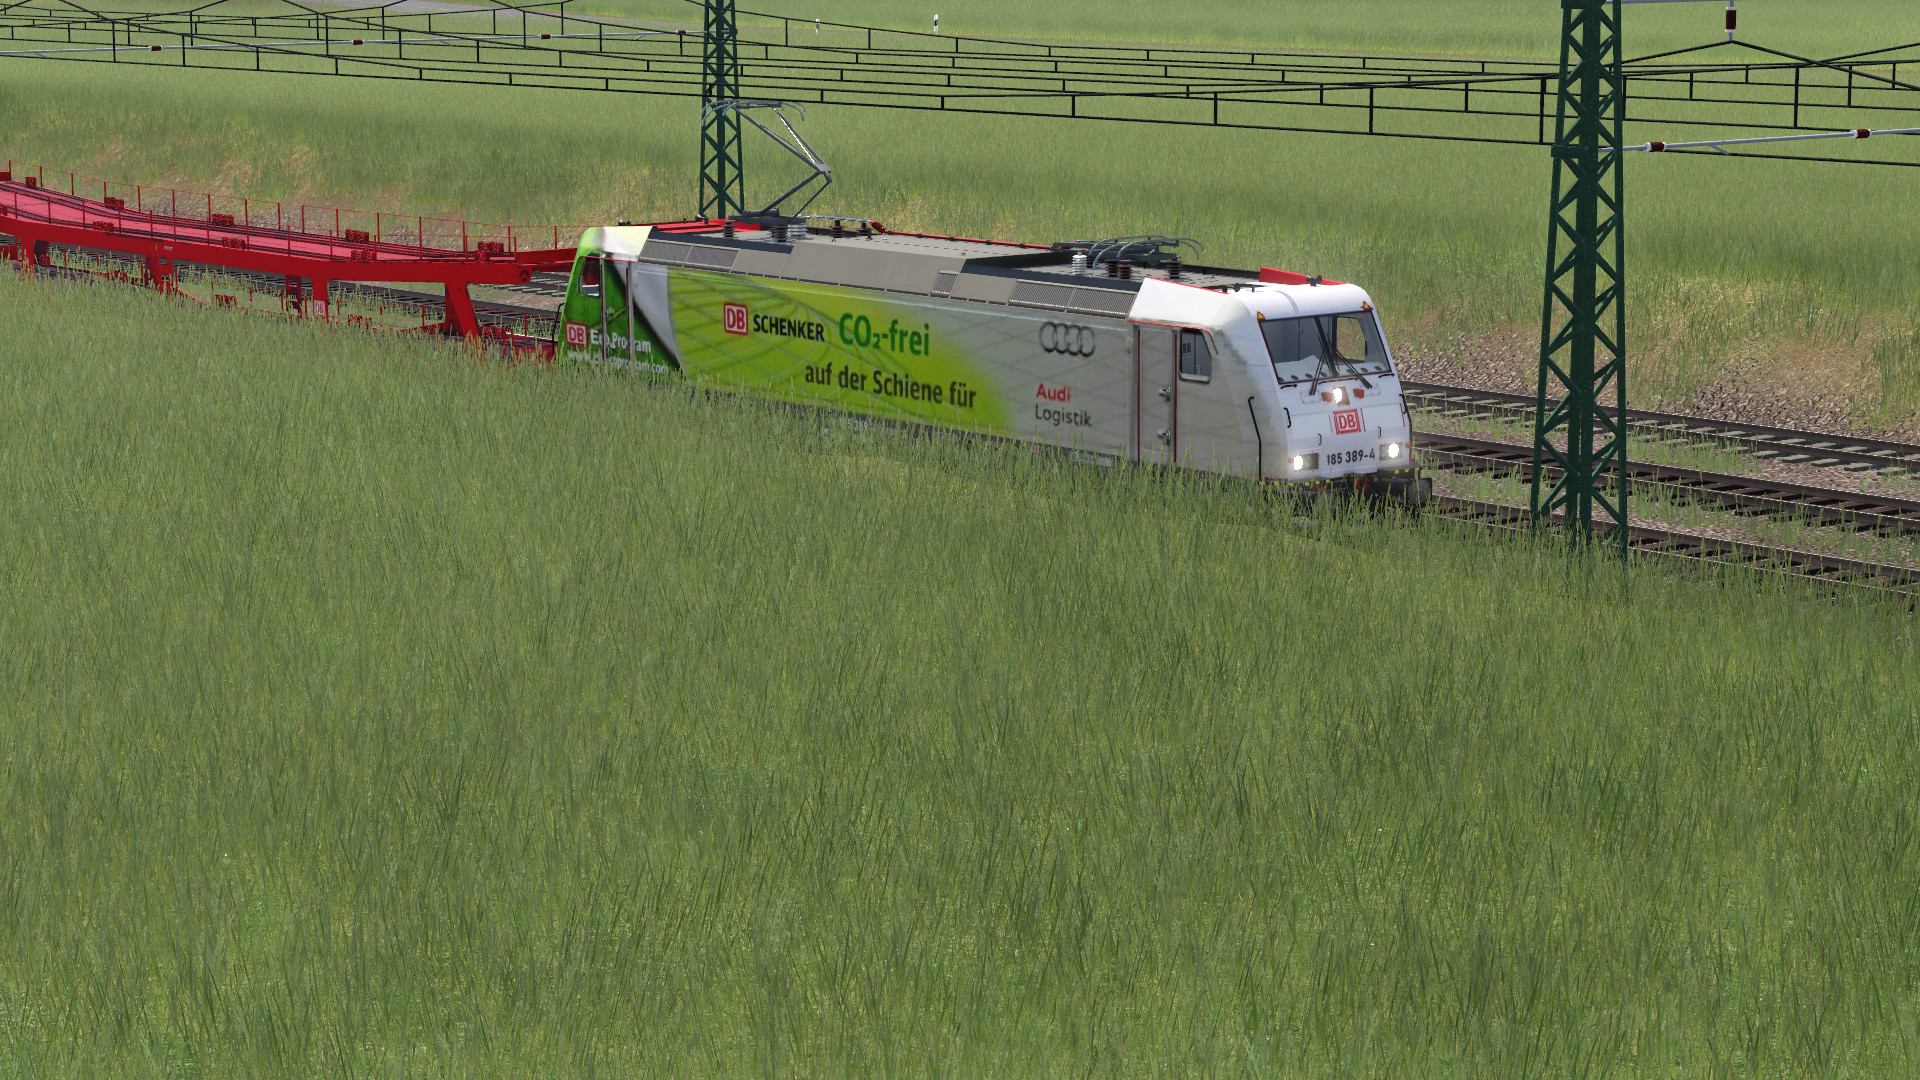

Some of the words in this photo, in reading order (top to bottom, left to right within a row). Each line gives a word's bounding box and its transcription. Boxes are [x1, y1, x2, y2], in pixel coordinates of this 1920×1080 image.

[725, 304, 748, 334] DB
[753, 314, 825, 342] SCHENKER
[566, 324, 587, 346] DB
[805, 361, 832, 386] auf
[838, 366, 867, 391] der
[873, 370, 943, 404] Schiene
[949, 381, 977, 408] für
[1036, 383, 1070, 404] Audi
[1035, 403, 1092, 428] Logistik
[1336, 411, 1359, 432] DB
[1327, 452, 1343, 466] 185
[1345, 448, 1376, 463] 389-4
